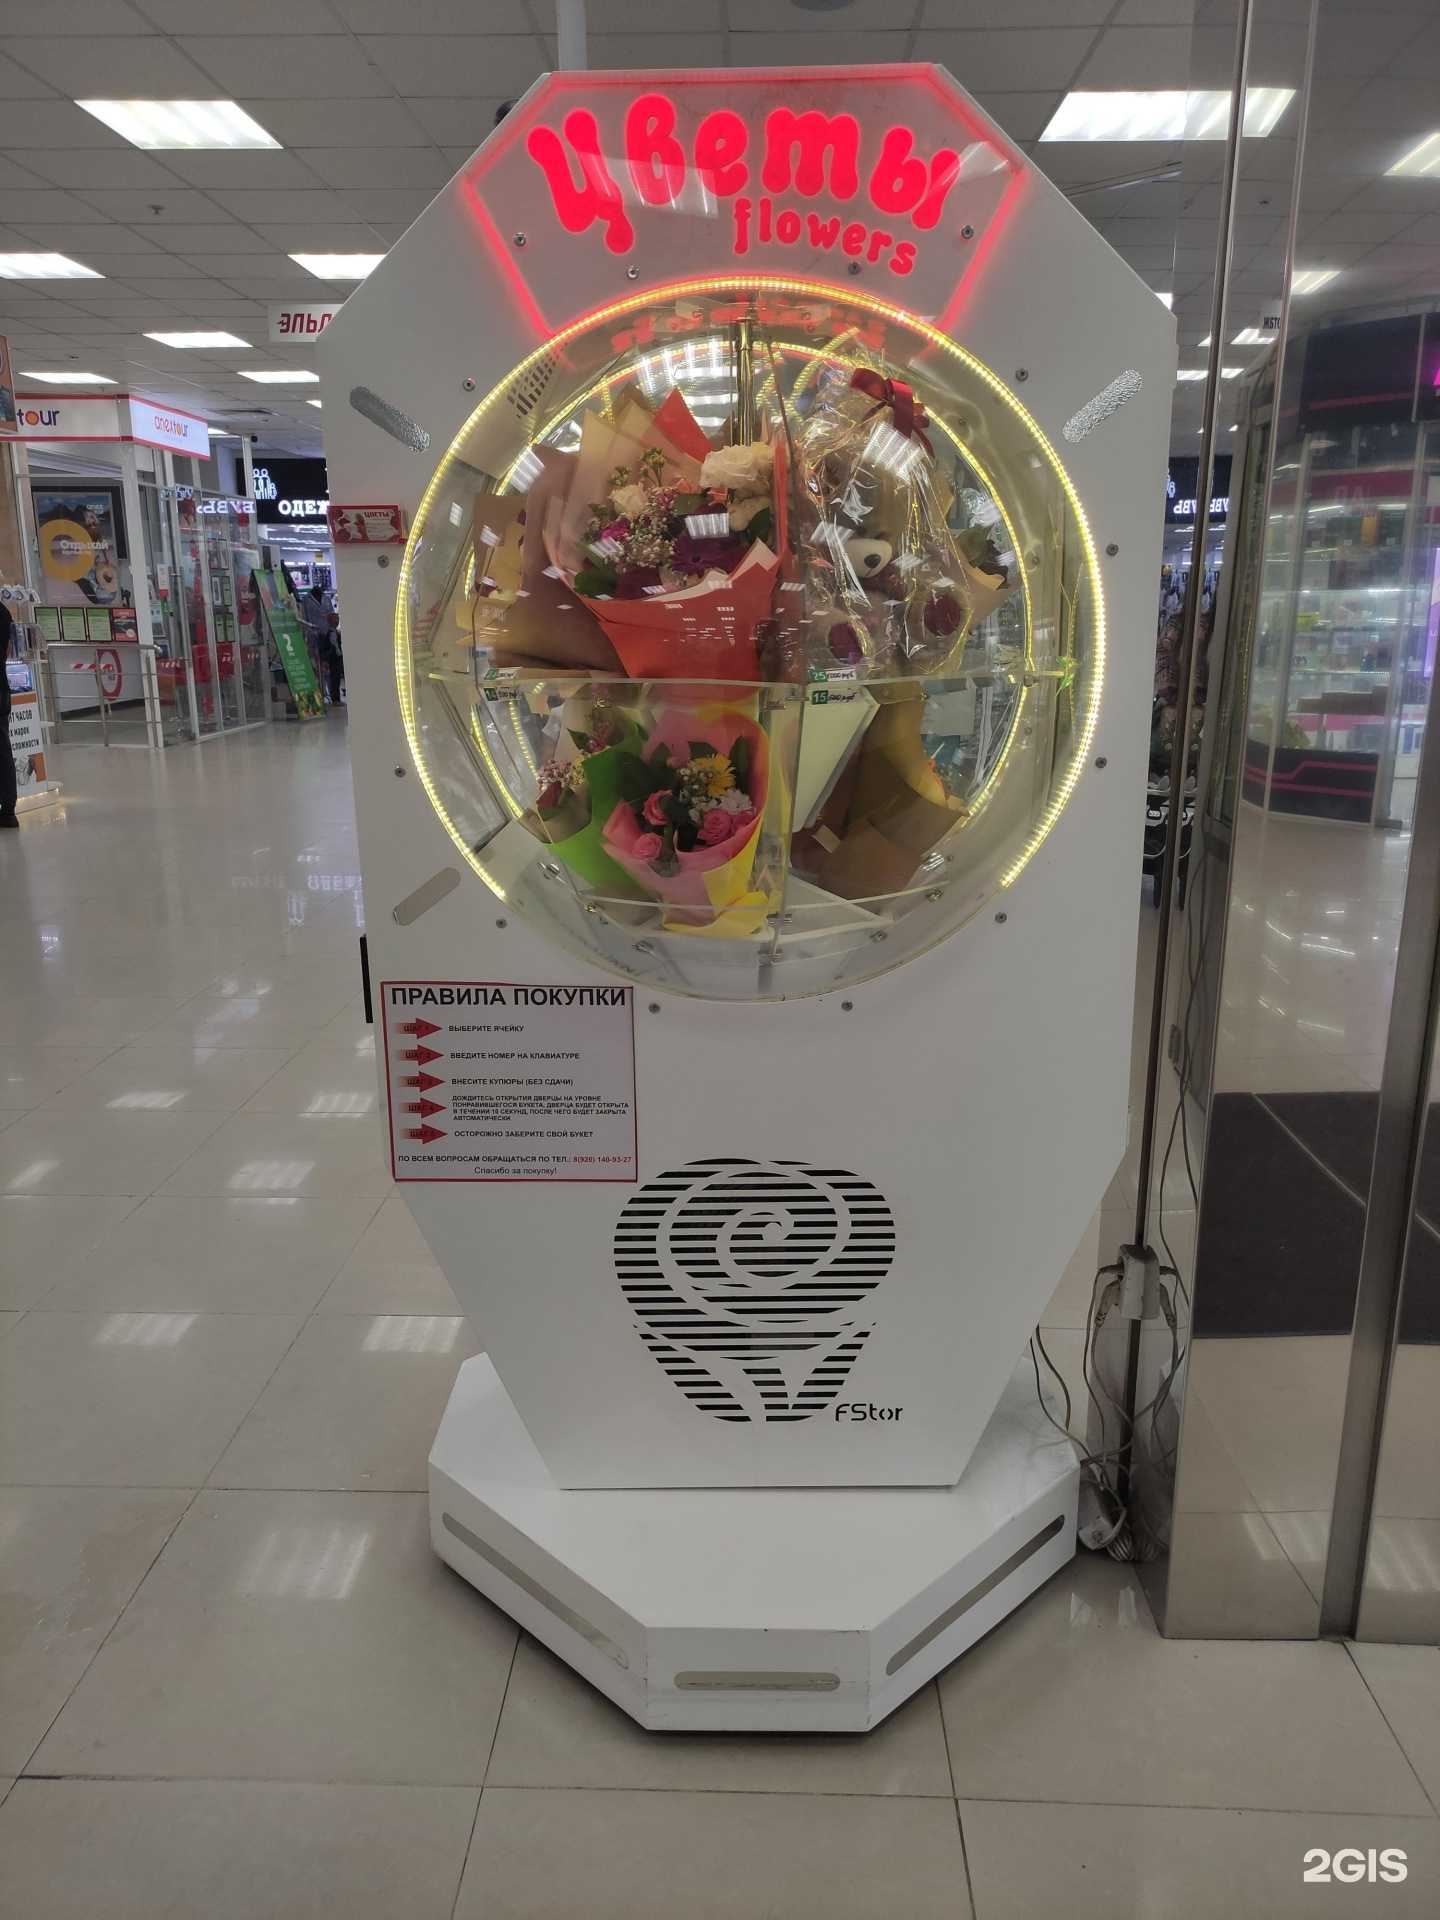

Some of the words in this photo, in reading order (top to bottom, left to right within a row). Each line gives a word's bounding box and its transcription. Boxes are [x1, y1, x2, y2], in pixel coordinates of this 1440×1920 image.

[733, 197, 917, 275] flowers
[16, 408, 60, 427] tour
[154, 415, 190, 438] anextour
[813, 671, 826, 680] 25
[814, 692, 826, 702] 15
[391, 987, 507, 1006] ПРАВИЛА
[514, 988, 626, 1006] ПОКУПКИ
[494, 1024, 524, 1032] ЯЧЕЙКУ
[450, 1052, 486, 1060] ВВЕДИТЕ
[530, 1052, 580, 1060] КЛАВИАТУРЕ
[525, 1078, 543, 1086] (БЕЗ
[545, 1078, 574, 1086] СДАЧИ)
[454, 1130, 503, 1138] ОСТОРОЖНО
[505, 1130, 544, 1138] ЗАБЕРИТЕ
[546, 1130, 568, 1138] СВОЙ
[570, 1130, 593, 1138] БУКЕТ
[474, 1166, 510, 1174] Спасибо
[523, 1167, 557, 1176] покупку!
[835, 1403, 904, 1421] FStor
